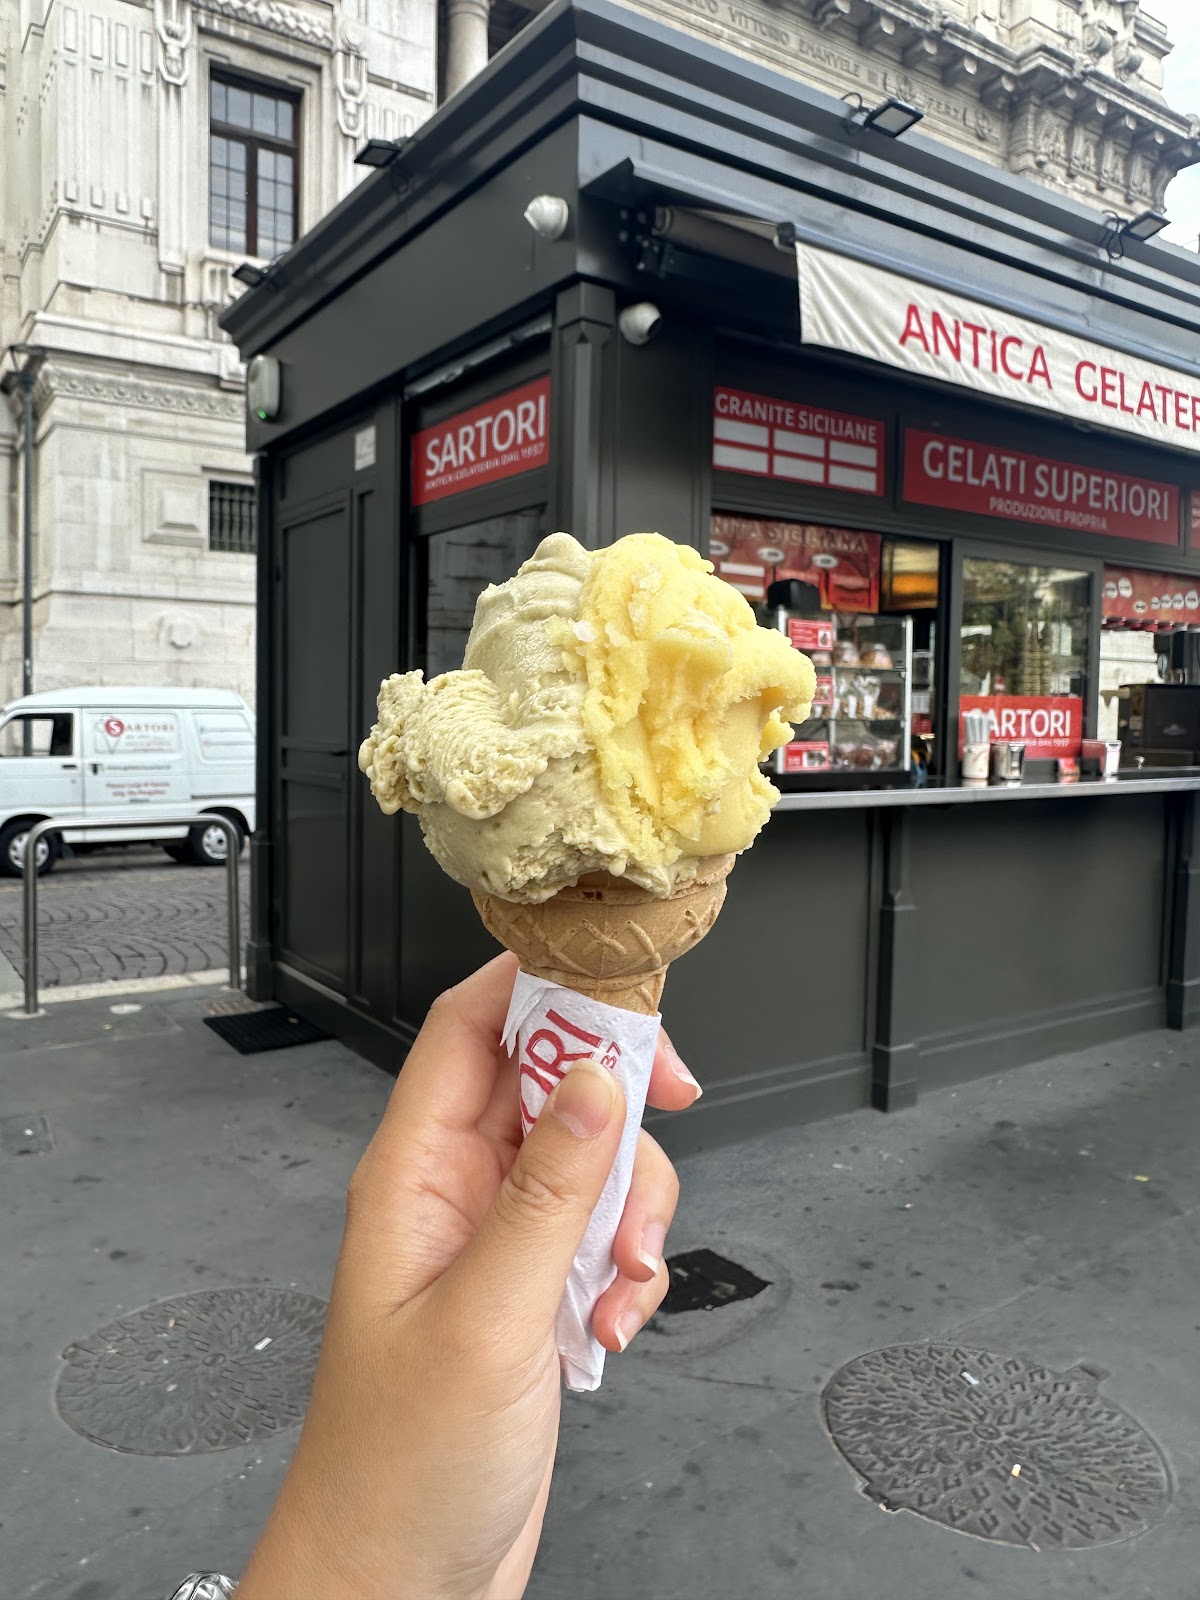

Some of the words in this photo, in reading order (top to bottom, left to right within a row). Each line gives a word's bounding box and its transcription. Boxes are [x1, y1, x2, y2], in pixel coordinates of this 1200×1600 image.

[899, 303, 1053, 390] ANTICA
[425, 394, 546, 477] SARTORI
[714, 393, 795, 428] GRANITE
[798, 410, 877, 444] SICILIANE
[923, 440, 1026, 494] GELATI
[1034, 463, 1169, 522] SUPERIORI
[989, 496, 1062, 524] PRODUZIONE
[1063, 509, 1108, 531] PROPRIA
[972, 708, 1071, 738] ARTORI
